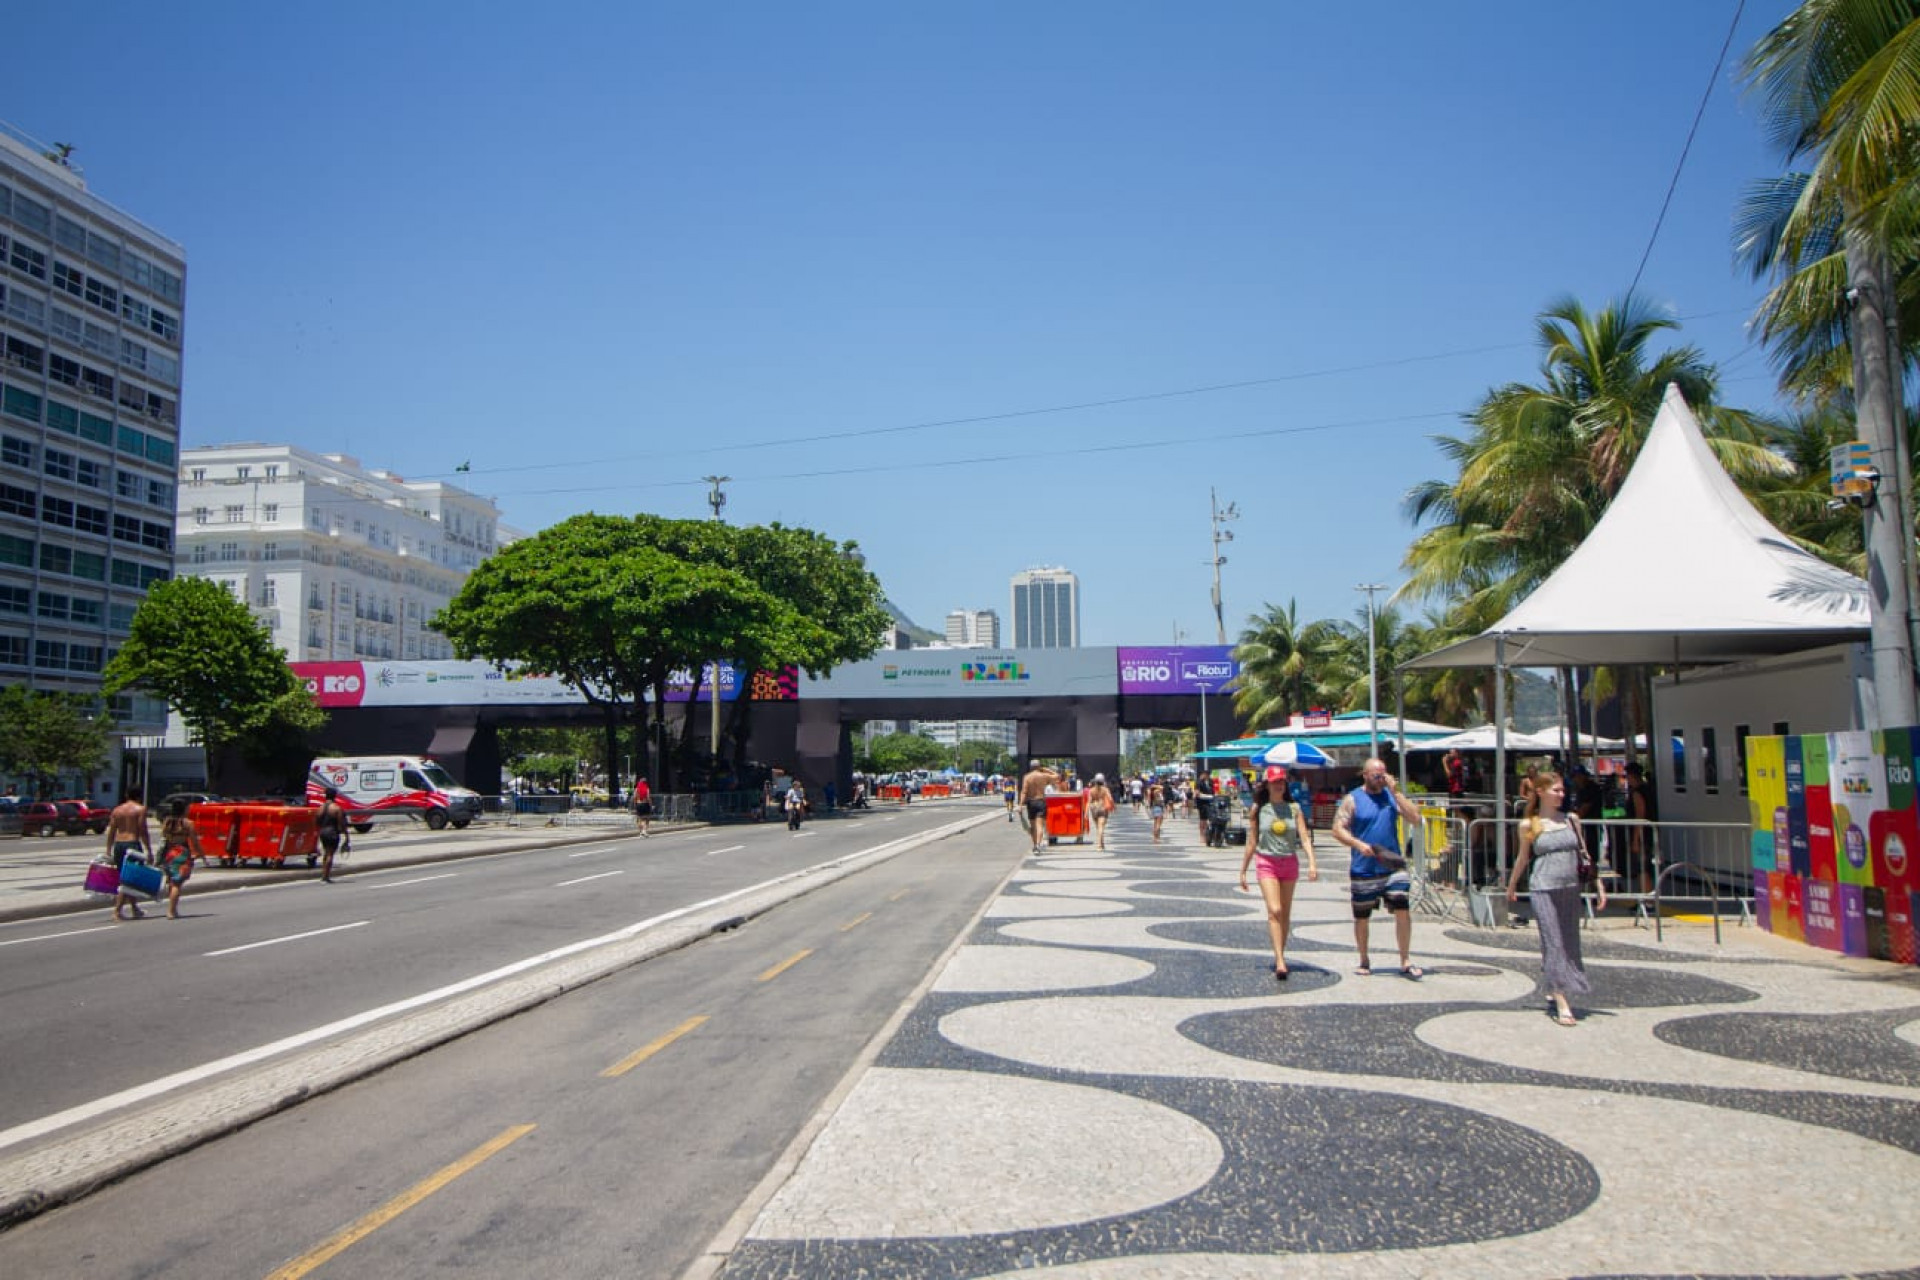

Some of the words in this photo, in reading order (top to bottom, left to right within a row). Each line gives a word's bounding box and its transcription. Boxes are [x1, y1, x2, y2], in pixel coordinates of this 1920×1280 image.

[901, 668, 951, 677] PETROBRAS
[961, 663, 1030, 681] BRASIL
[1137, 666, 1170, 682] RIO
[1197, 664, 1229, 677] Riotur
[1888, 763, 1911, 783] RIO
